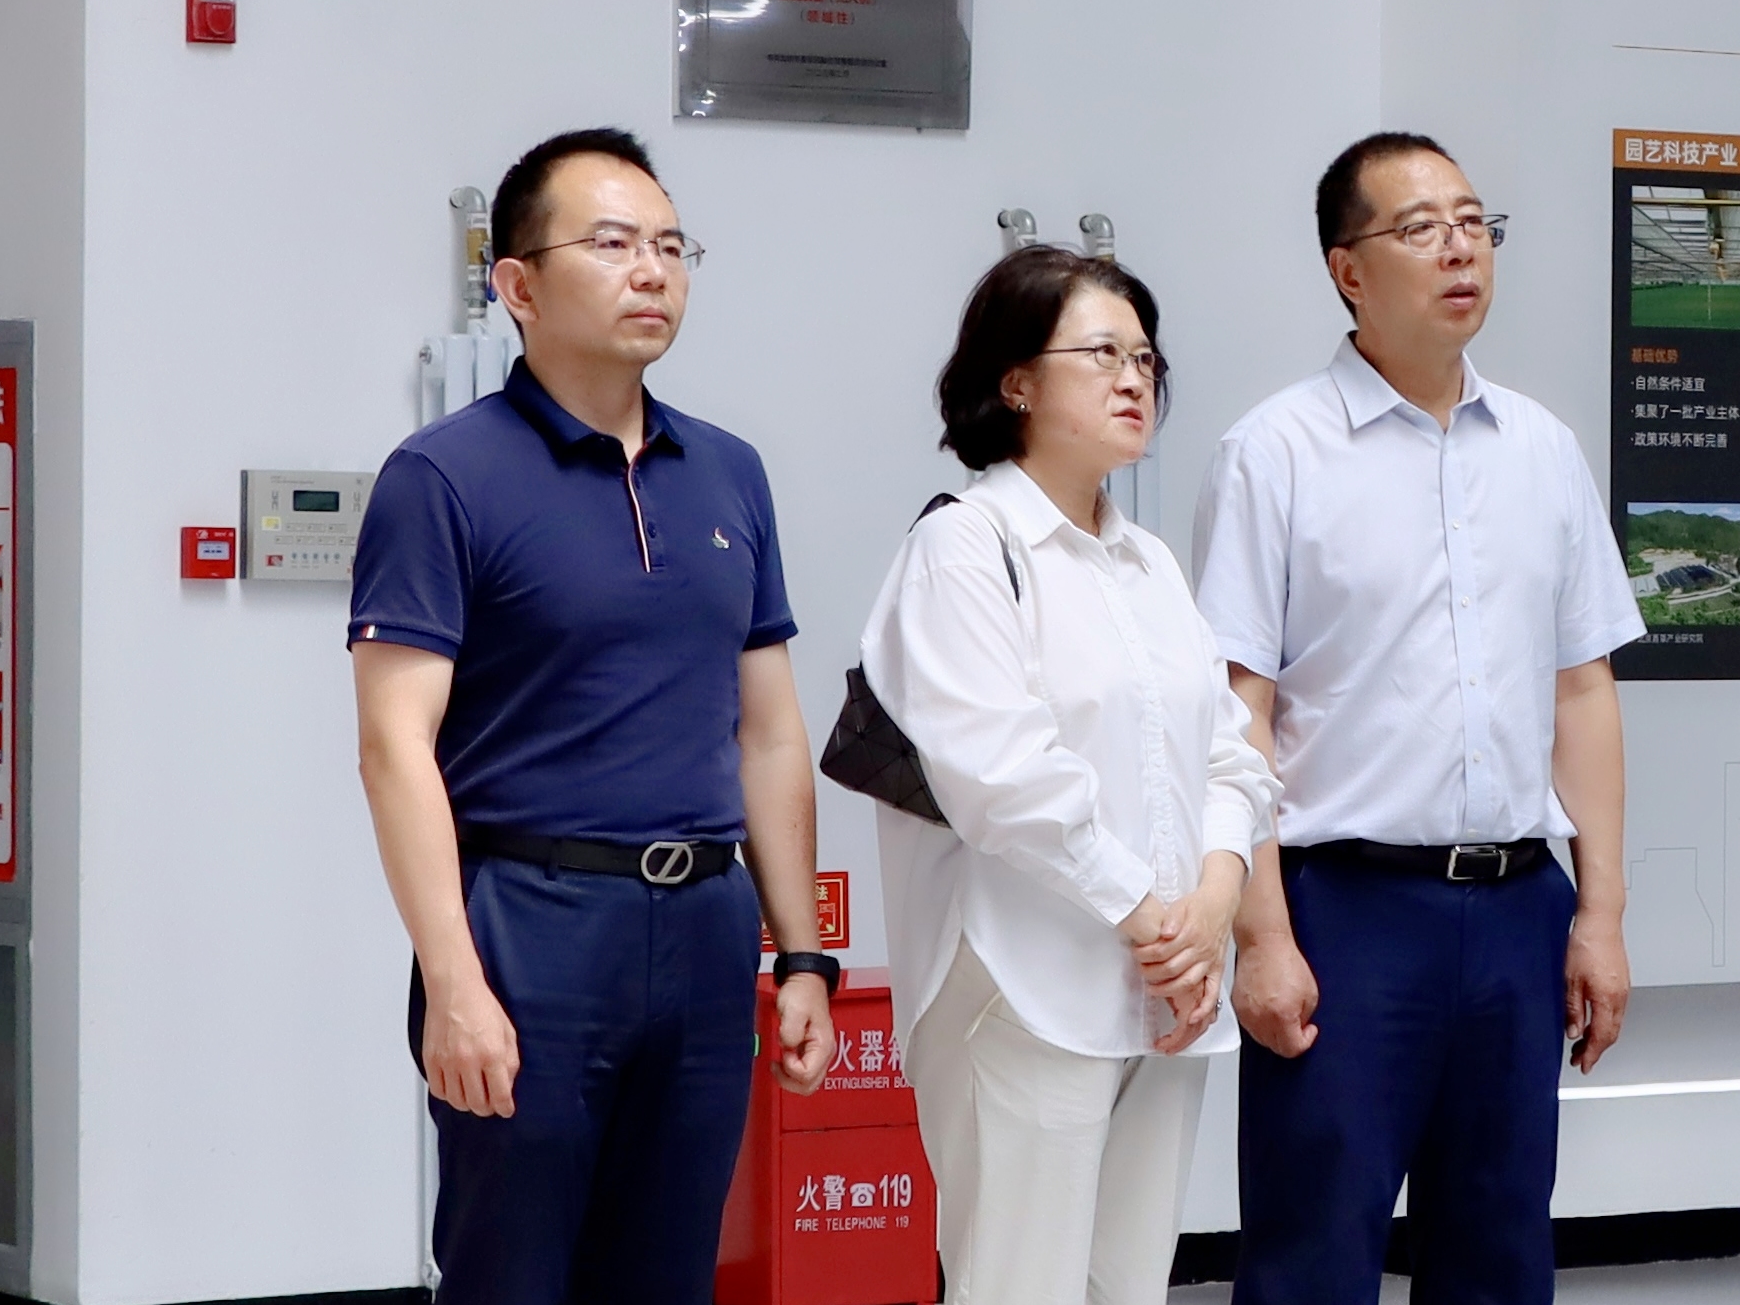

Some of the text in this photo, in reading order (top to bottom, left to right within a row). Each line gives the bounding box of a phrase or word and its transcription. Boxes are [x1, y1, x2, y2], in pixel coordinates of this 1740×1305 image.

[1625, 138, 1738, 166] 园艺科技产业
[1635, 375, 1705, 392] 自然条件适宜
[1634, 404, 1740, 421] 集聚了一批产业主体
[1634, 432, 1727, 449] 政策环境不断完善
[825, 1077, 890, 1090] EXTINGUISHER
[795, 1174, 912, 1212] 火警 119
[795, 1215, 910, 1232] FIRE TELEPHONE 119
